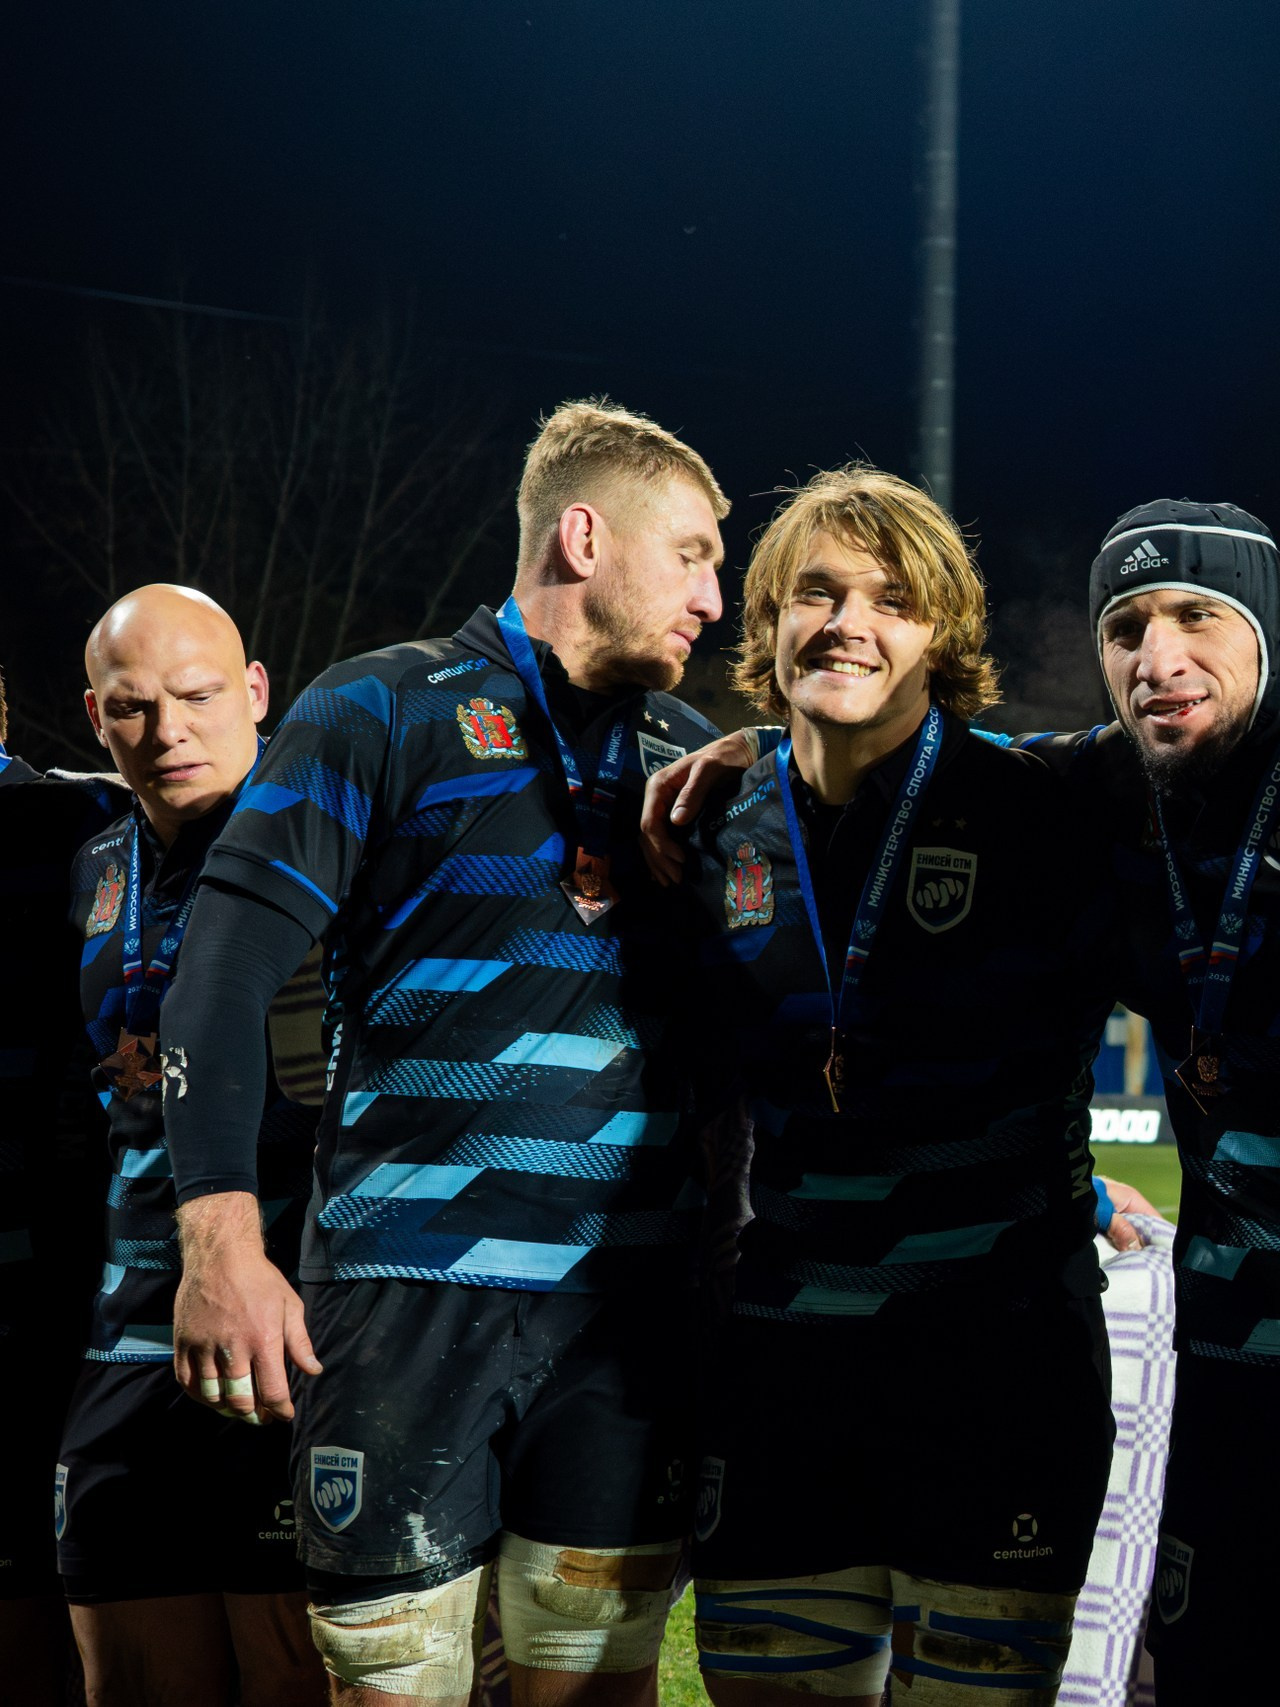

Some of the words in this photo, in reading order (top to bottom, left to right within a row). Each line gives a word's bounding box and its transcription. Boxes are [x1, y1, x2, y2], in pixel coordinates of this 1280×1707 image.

[867, 798, 914, 908] МИНИСТЕРСТВО
[906, 745, 935, 798] СПОРТА
[1231, 784, 1279, 901] МИНИСТЕРСТВО
[917, 853, 952, 868] ЕНИСЕЙ
[953, 858, 972, 870] СТМ
[1208, 972, 1231, 984] 2026
[313, 1453, 341, 1467] ЕНИСЕЙ
[341, 1457, 359, 1469] СТМ
[992, 1545, 1054, 1560] centurion
